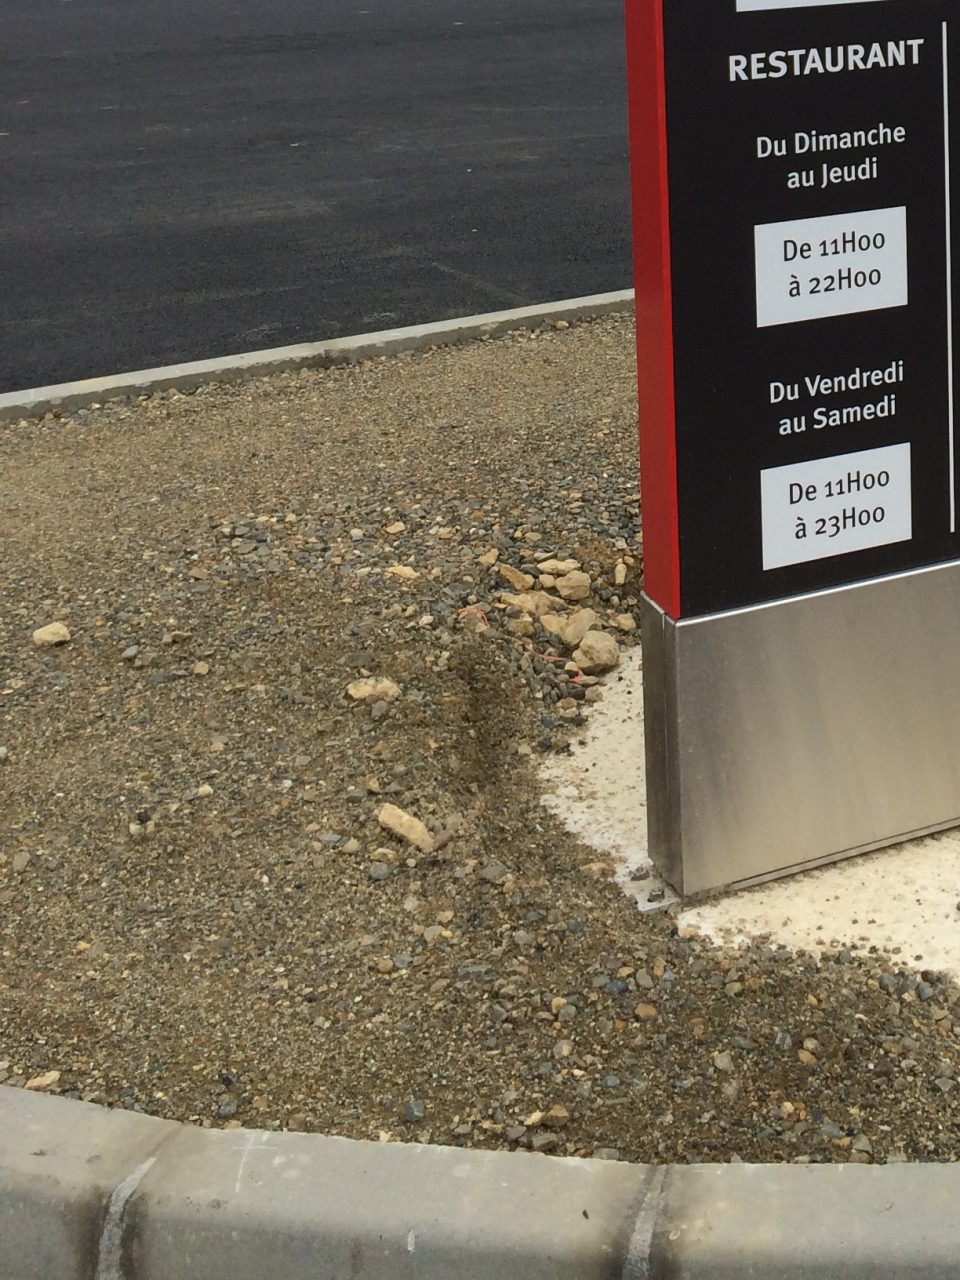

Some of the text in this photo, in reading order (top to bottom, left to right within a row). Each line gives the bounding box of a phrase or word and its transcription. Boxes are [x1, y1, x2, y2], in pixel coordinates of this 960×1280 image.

[728, 38, 925, 82] RESTAURANT
[756, 122, 906, 158] Du Dimanche
[787, 156, 878, 189] au Jeudi
[783, 239, 812, 262] De
[788, 274, 801, 298] à
[769, 359, 904, 404] Du Vendredi
[779, 394, 896, 436] au Samedi
[789, 482, 817, 505] De
[795, 516, 807, 540] à
